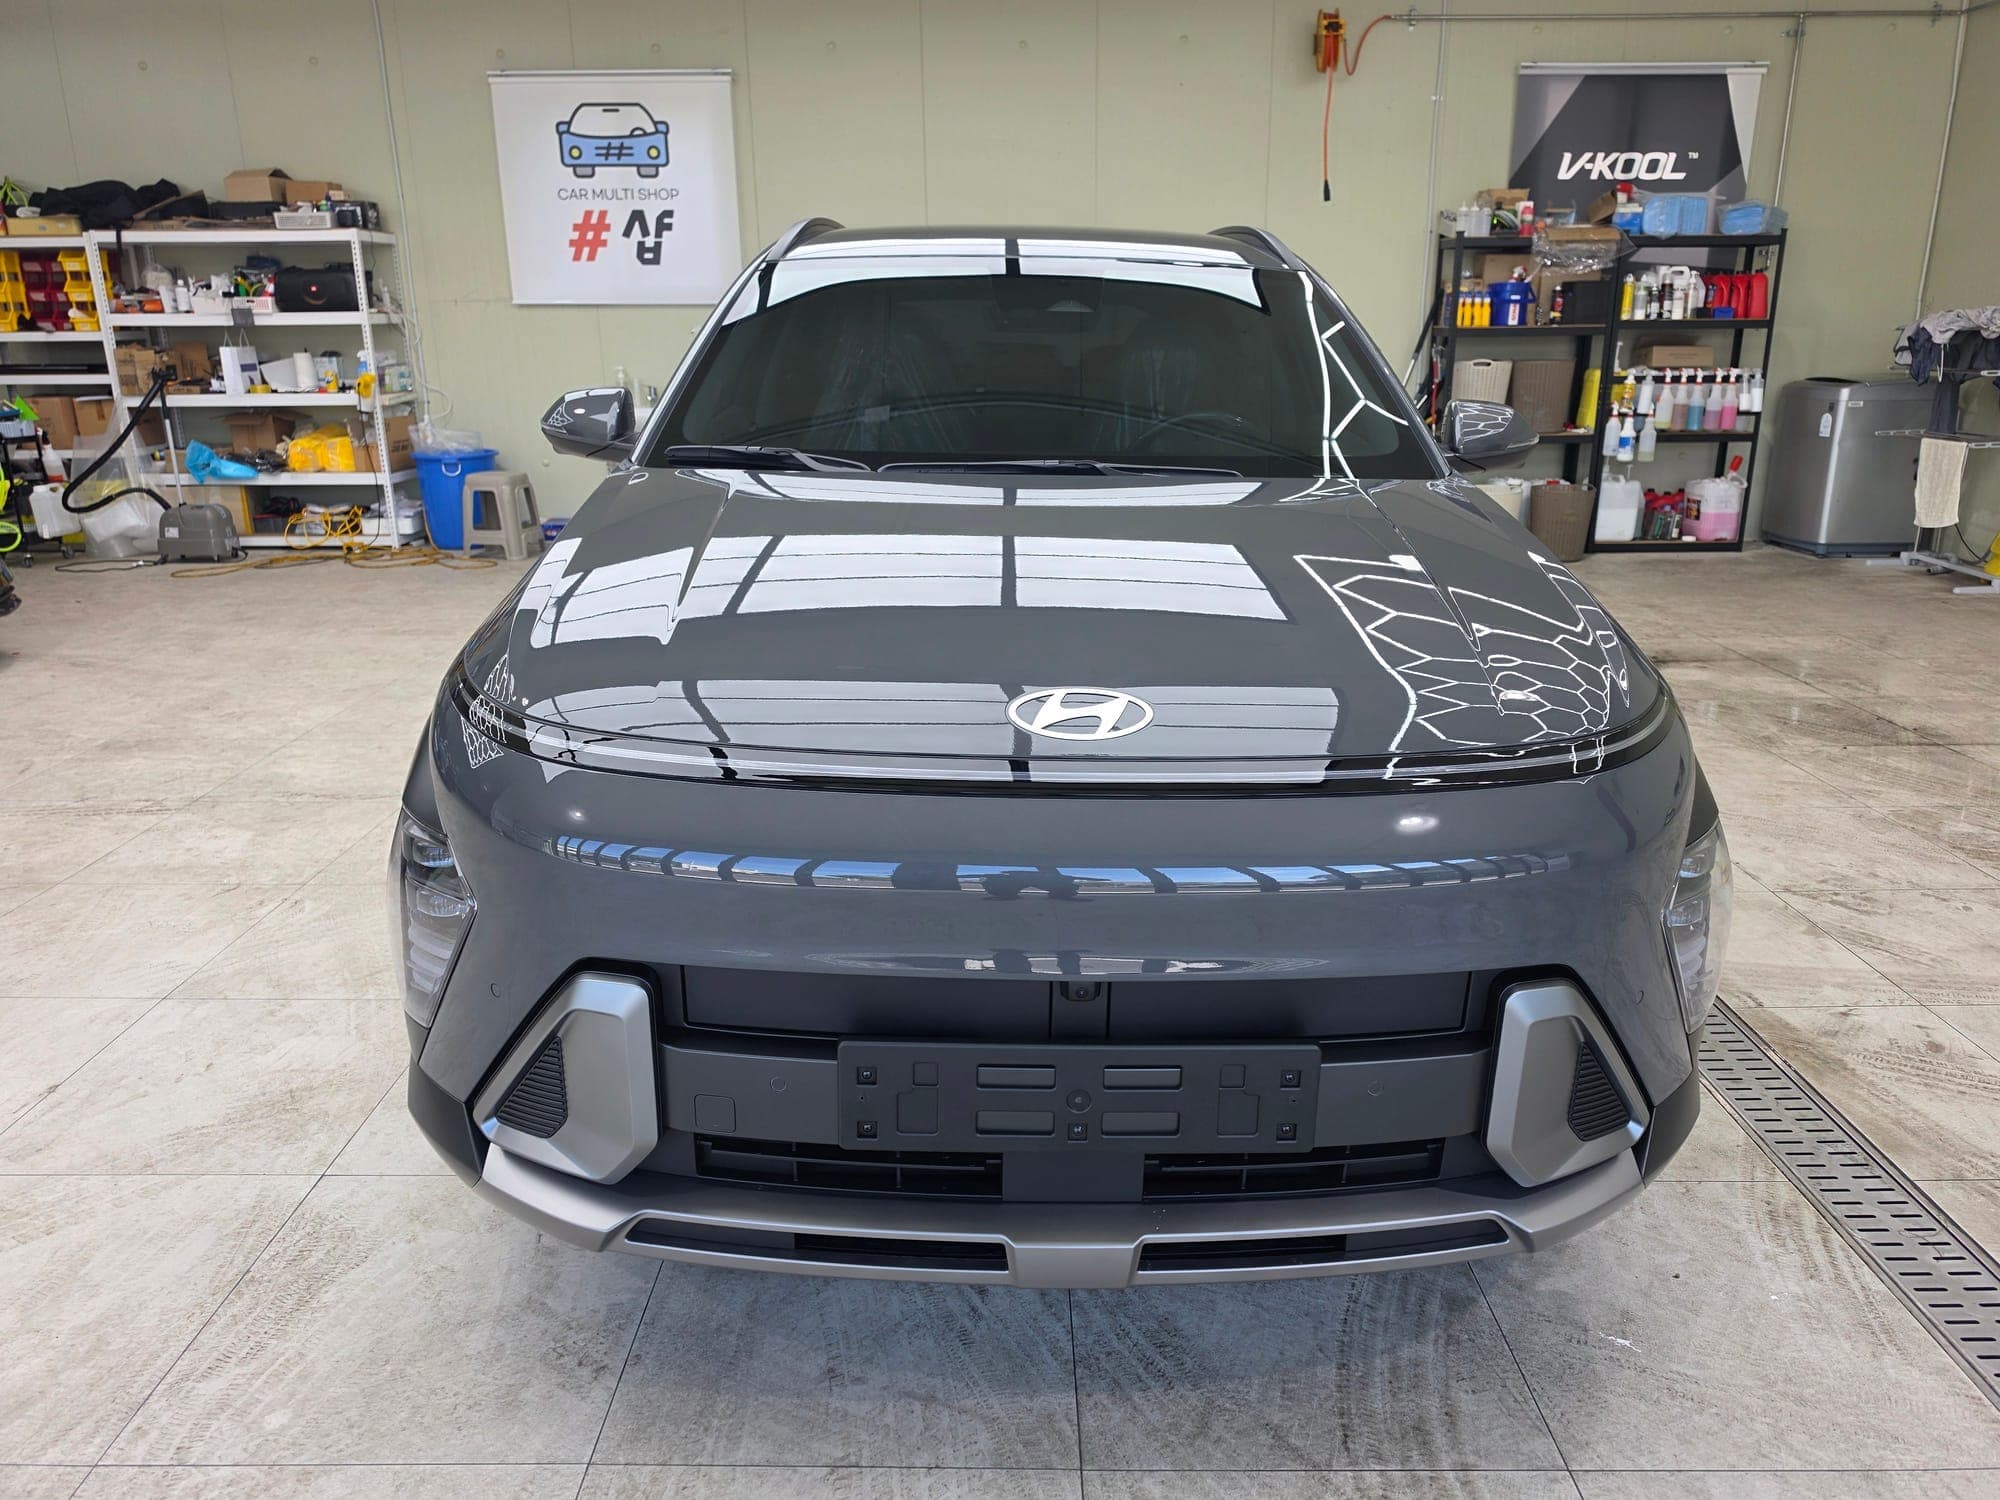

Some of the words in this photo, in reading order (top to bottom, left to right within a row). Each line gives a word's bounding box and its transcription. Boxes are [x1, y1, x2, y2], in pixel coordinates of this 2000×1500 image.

[1557, 152, 1687, 180] V-KOOL
[557, 188, 588, 201] CAR
[592, 187, 635, 201] MULTI
[639, 187, 679, 201] SHOP
